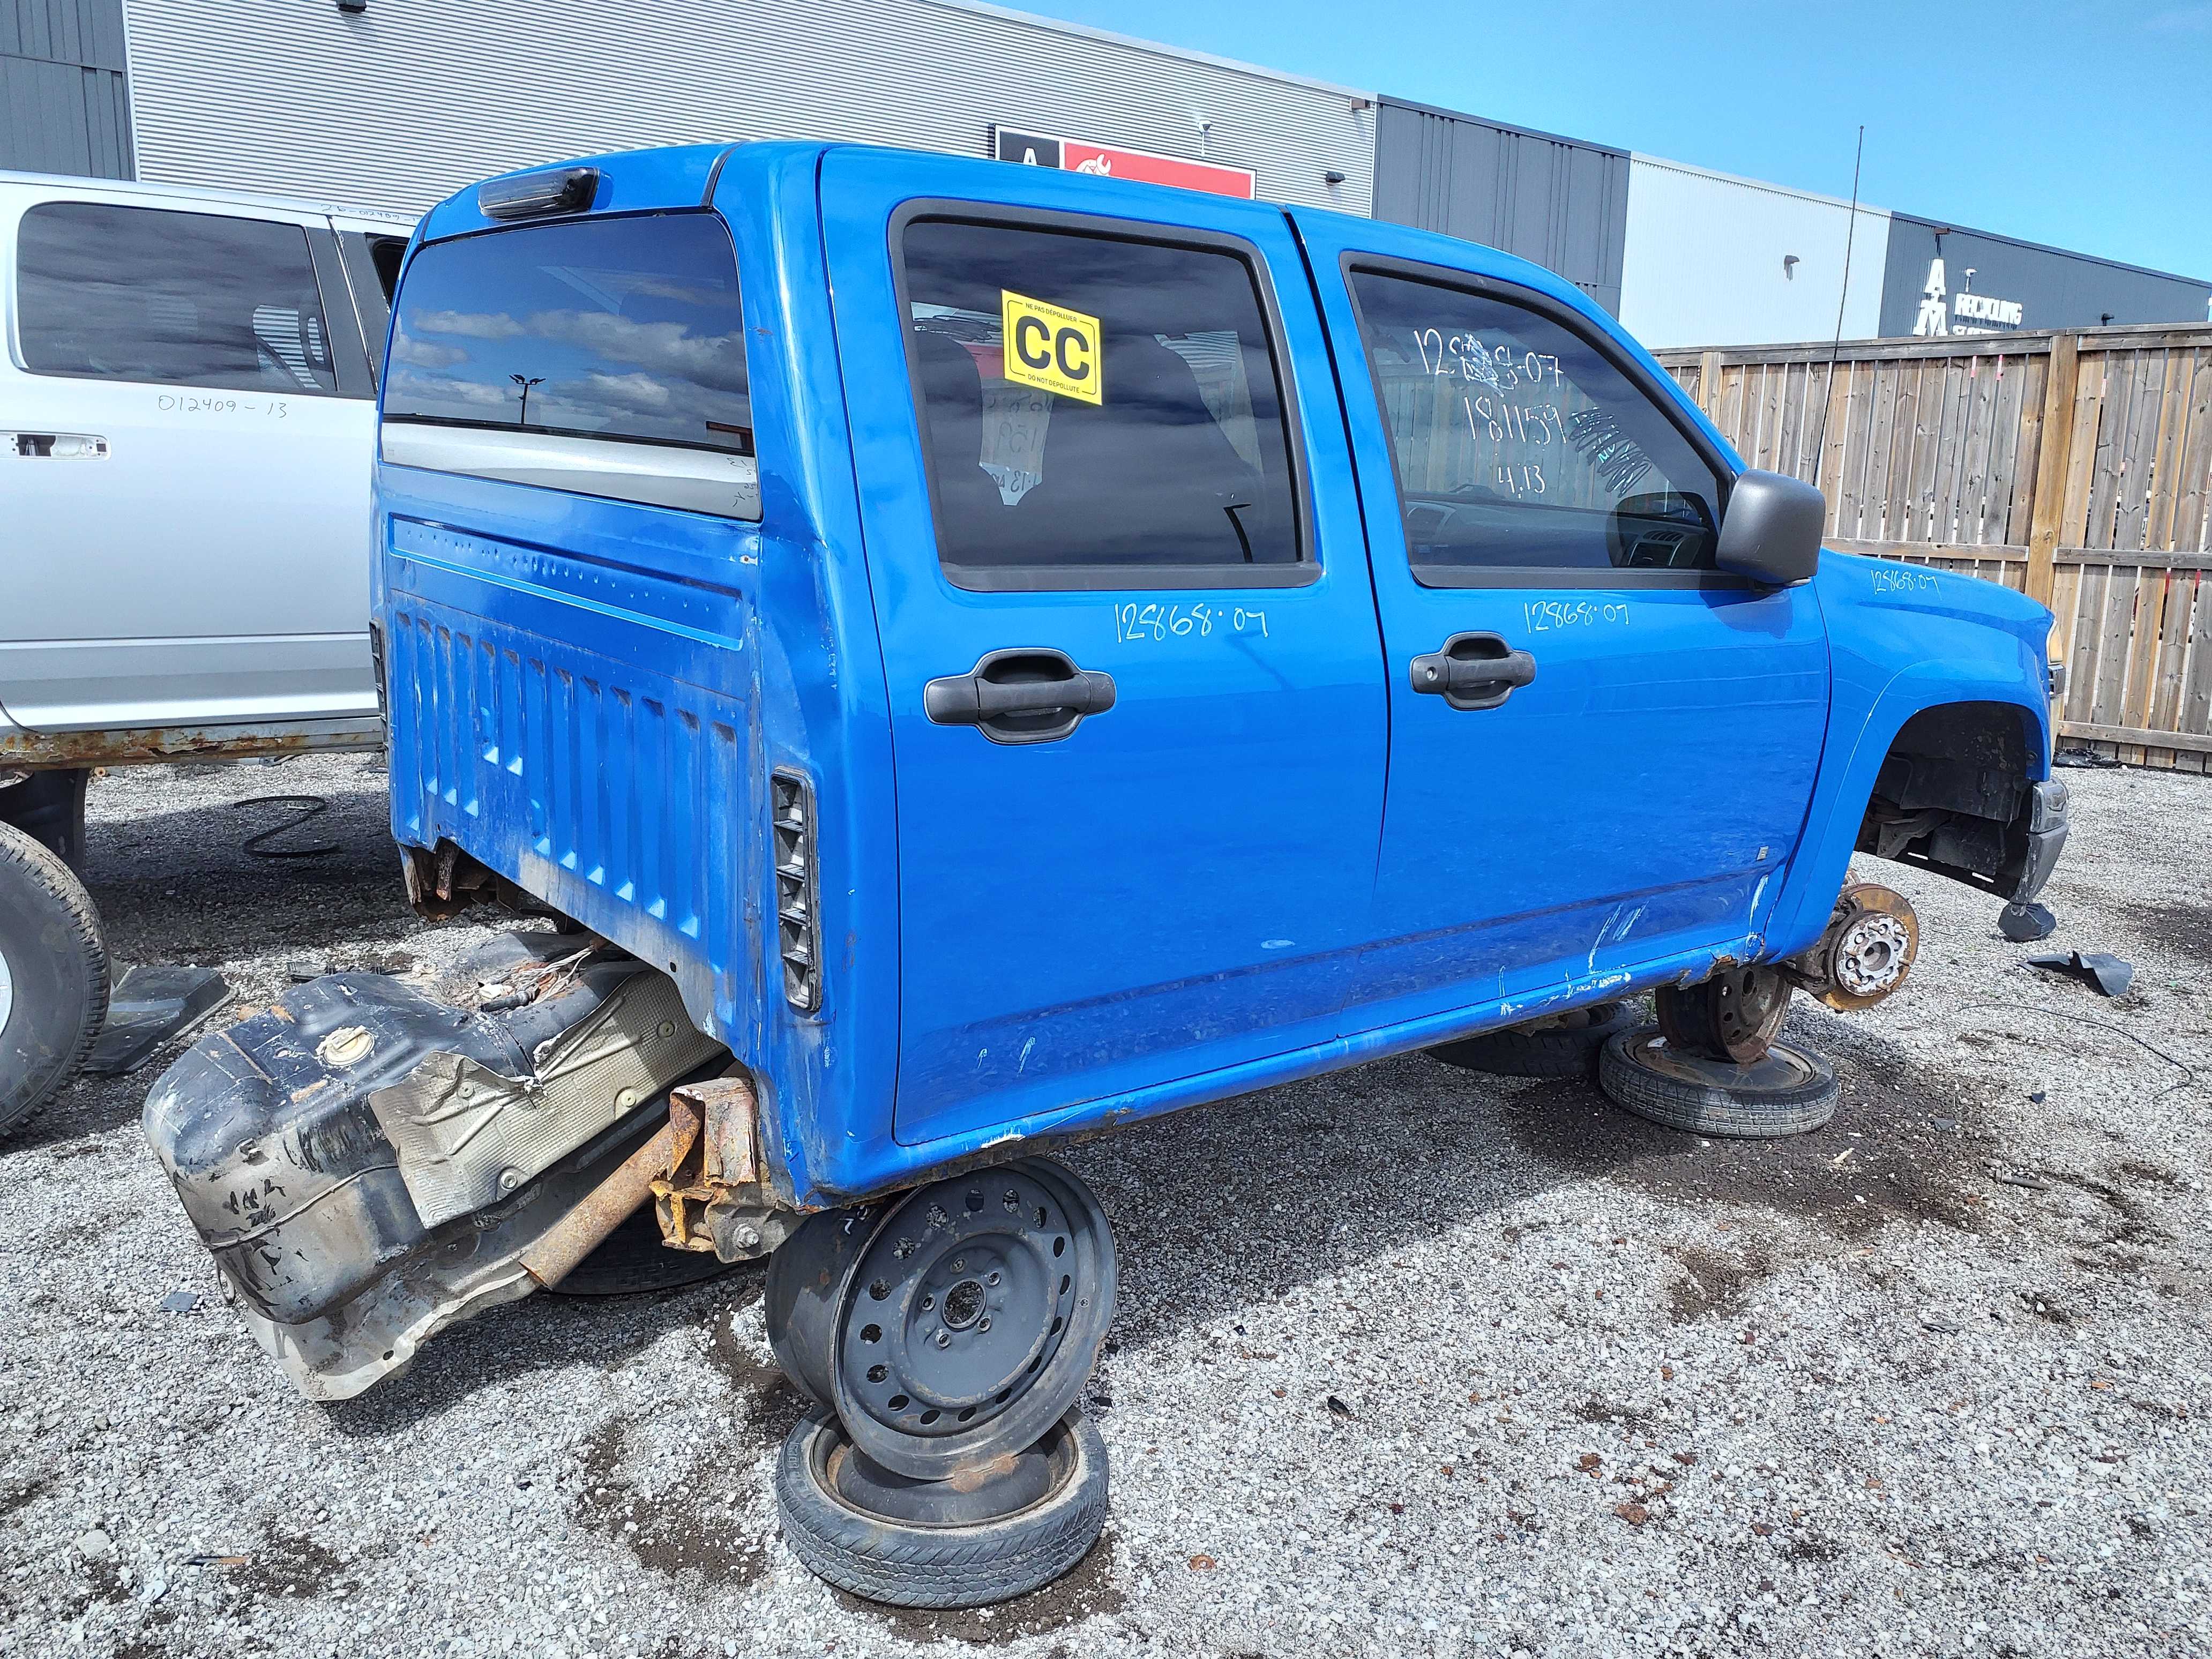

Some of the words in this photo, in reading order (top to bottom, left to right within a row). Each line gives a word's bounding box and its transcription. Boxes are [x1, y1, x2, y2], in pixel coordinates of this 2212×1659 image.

[1034, 305, 1045, 313] PAS
[1045, 309, 1077, 323] DÉPOLLUER
[1015, 315, 1089, 380] CC
[1036, 376, 1048, 384] NOT
[1049, 380, 1080, 393] DEPOLLUTE
